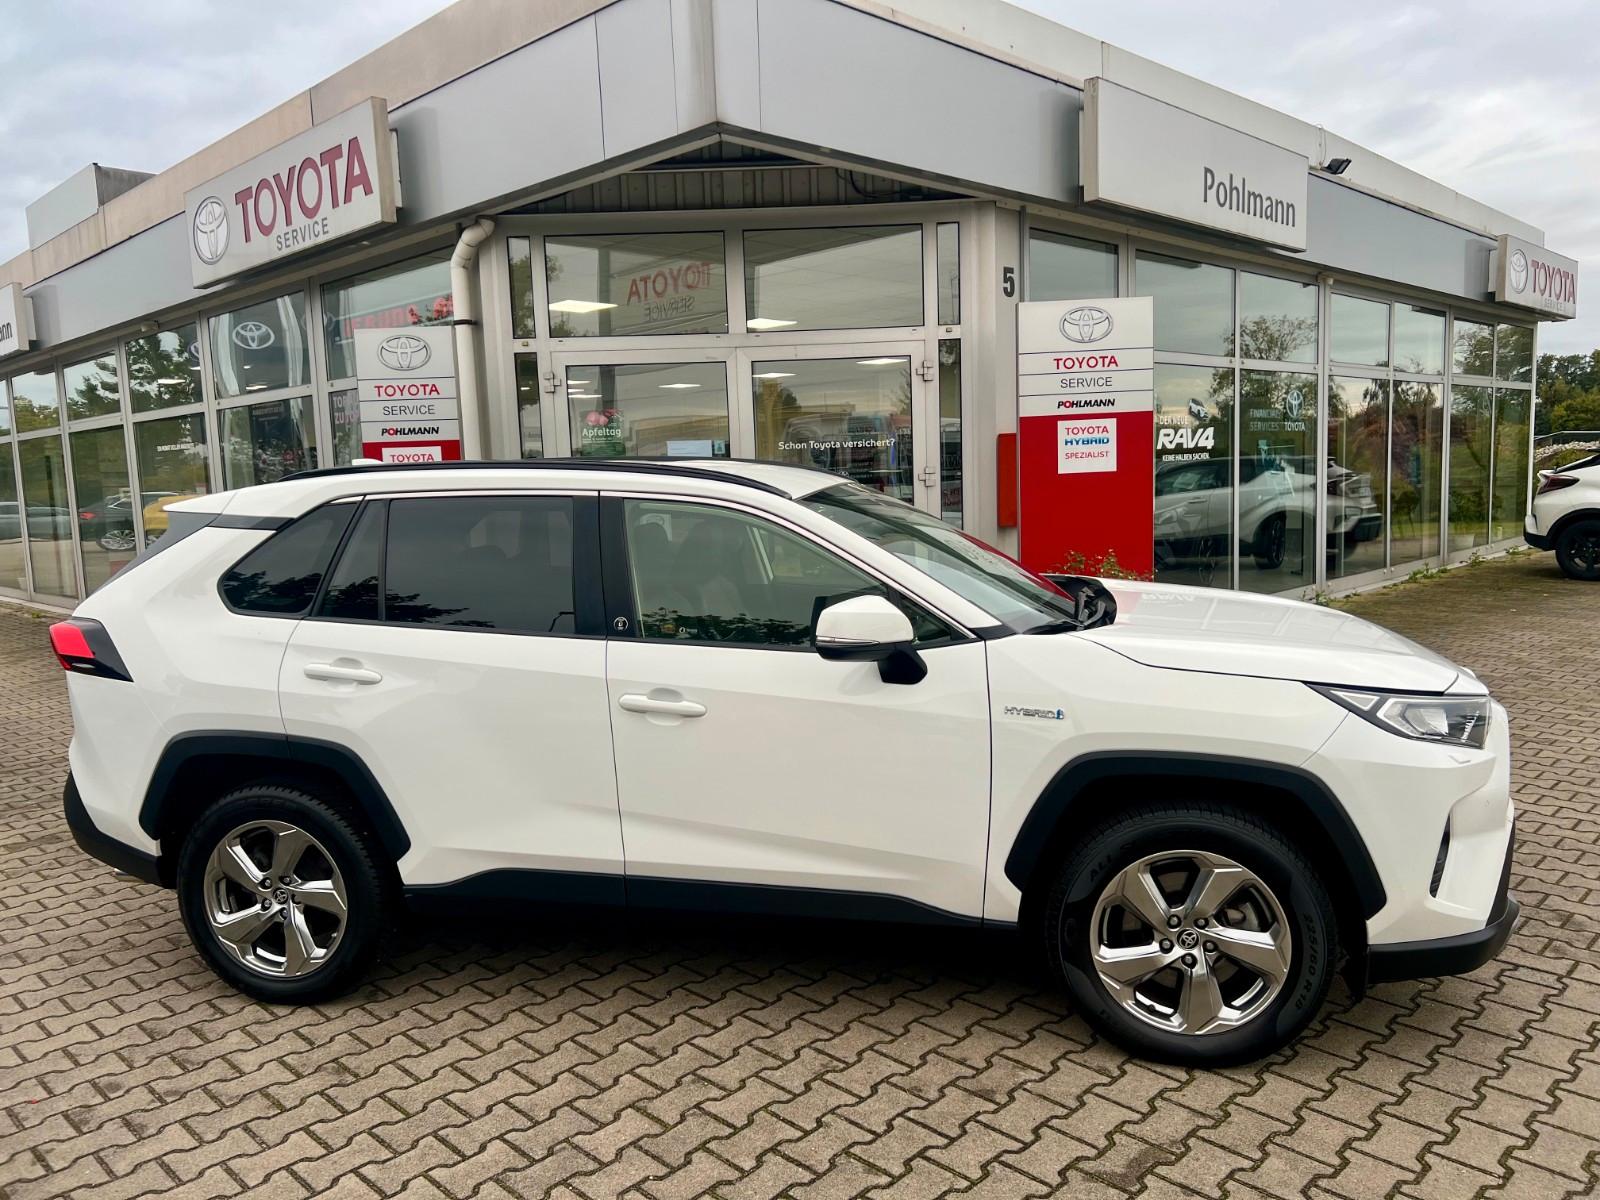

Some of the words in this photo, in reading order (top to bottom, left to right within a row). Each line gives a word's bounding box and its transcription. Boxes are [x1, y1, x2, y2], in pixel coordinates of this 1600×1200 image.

[234, 136, 374, 243] TOYOTA
[1203, 166, 1295, 227] Pohlmann
[276, 217, 329, 251] SERVICE
[1002, 266, 1015, 298] 5
[1531, 259, 1575, 304] TOYOTA
[1053, 355, 1119, 370] TOYOTA
[1060, 376, 1113, 389] SERVICE
[374, 384, 441, 397] TOYOTA
[383, 404, 436, 416] SERVICE
[1057, 398, 1115, 409] POHLMANN
[381, 426, 439, 437] POHLMANN
[1065, 425, 1109, 436] TOYOTA
[1284, 421, 1306, 431] TOYOTA
[582, 428, 622, 438] Apfeltag
[1156, 426, 1215, 449] RAV4
[778, 441, 807, 450] Schon
[809, 440, 841, 451] Toyota
[843, 438, 896, 448] versichert?
[1064, 437, 1110, 446] HYBRID
[390, 453, 434, 463] TOYOTA
[1065, 451, 1110, 460] SPEZIALIST
